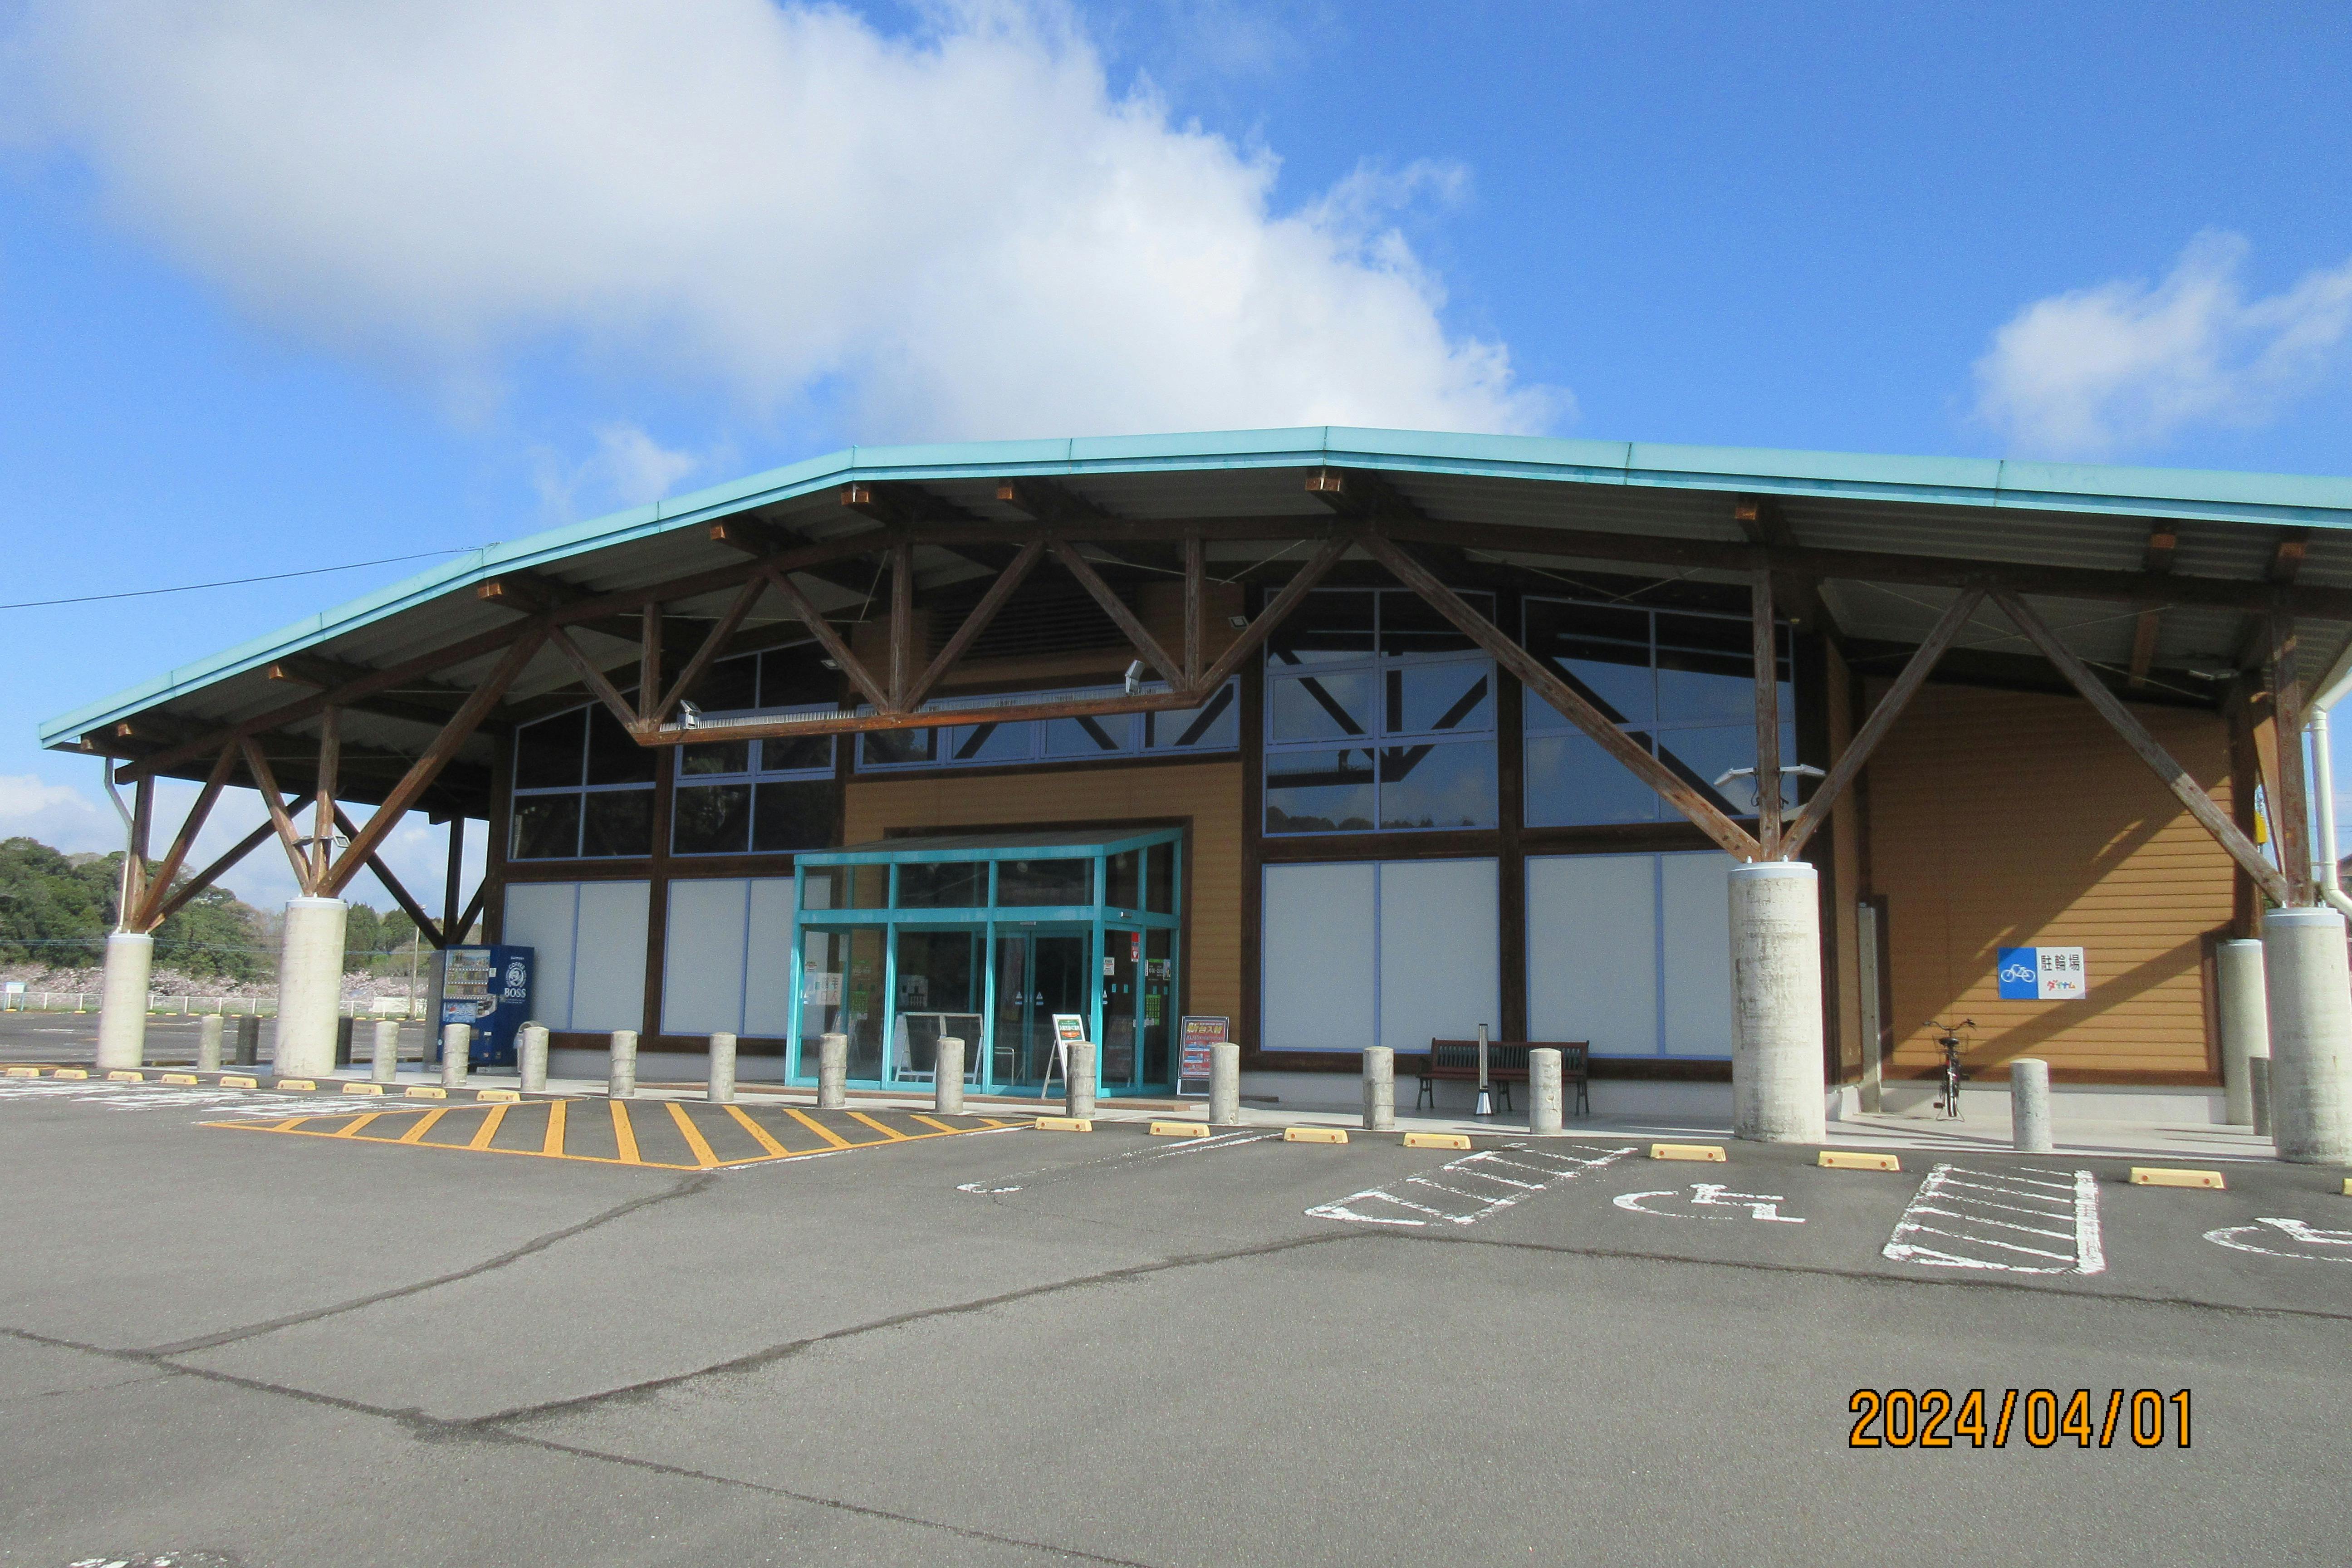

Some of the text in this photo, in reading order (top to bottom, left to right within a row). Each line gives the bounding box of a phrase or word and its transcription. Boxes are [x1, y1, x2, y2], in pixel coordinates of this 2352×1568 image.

[2040, 954, 2081, 971] 駐輪場
[2047, 980, 2077, 991] ダイナム
[504, 987, 526, 998] BOSS
